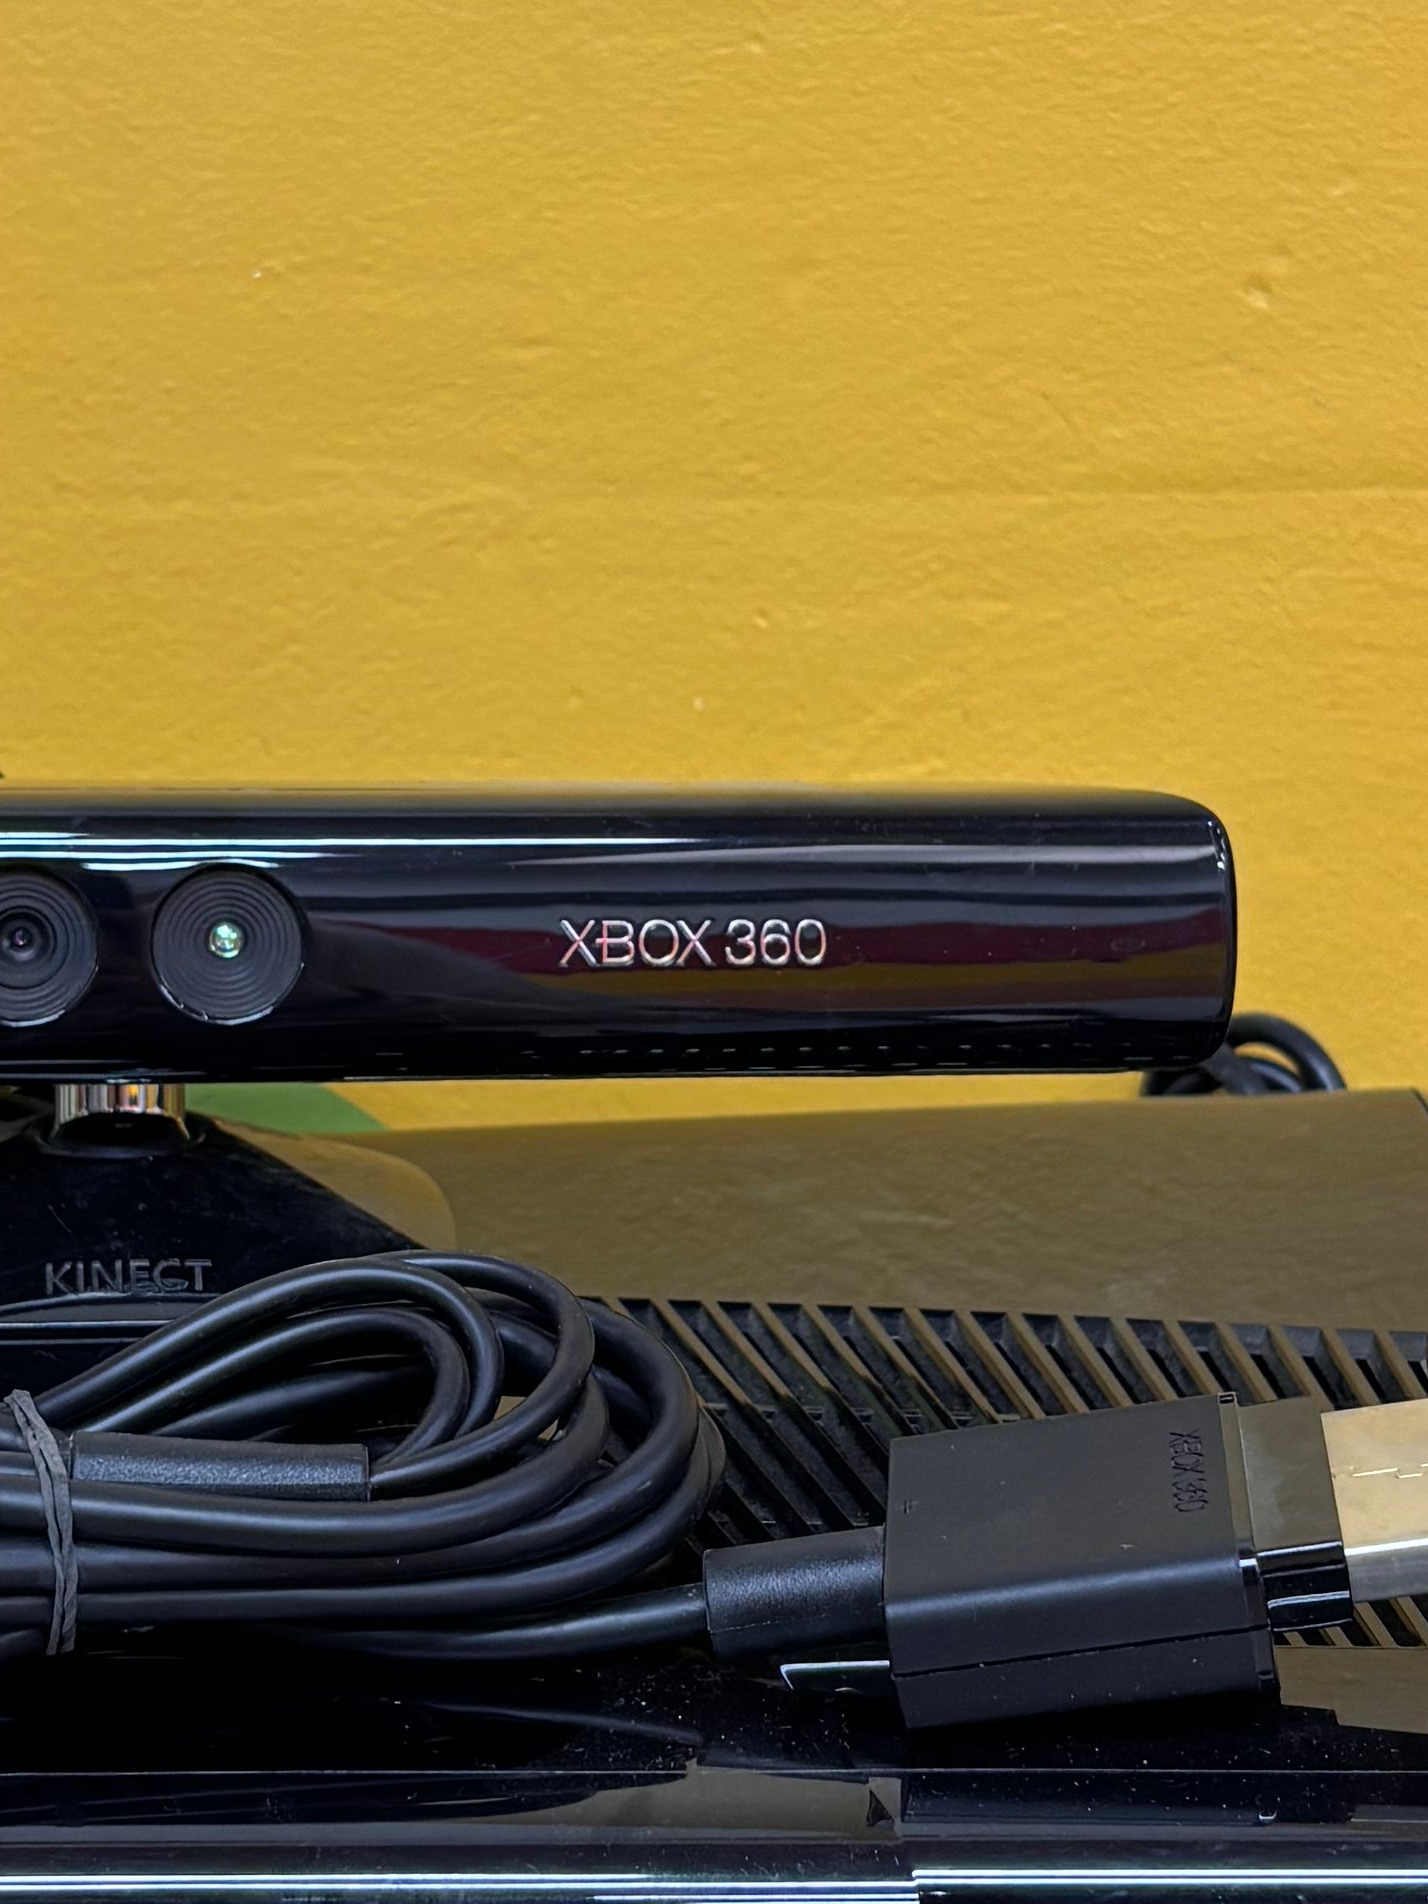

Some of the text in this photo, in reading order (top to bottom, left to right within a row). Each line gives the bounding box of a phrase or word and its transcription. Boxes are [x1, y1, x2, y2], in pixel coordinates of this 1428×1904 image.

[559, 919, 828, 967] XBOX 360
[44, 1258, 213, 1295] KINECT
[1169, 1429, 1205, 1478] XBOX
